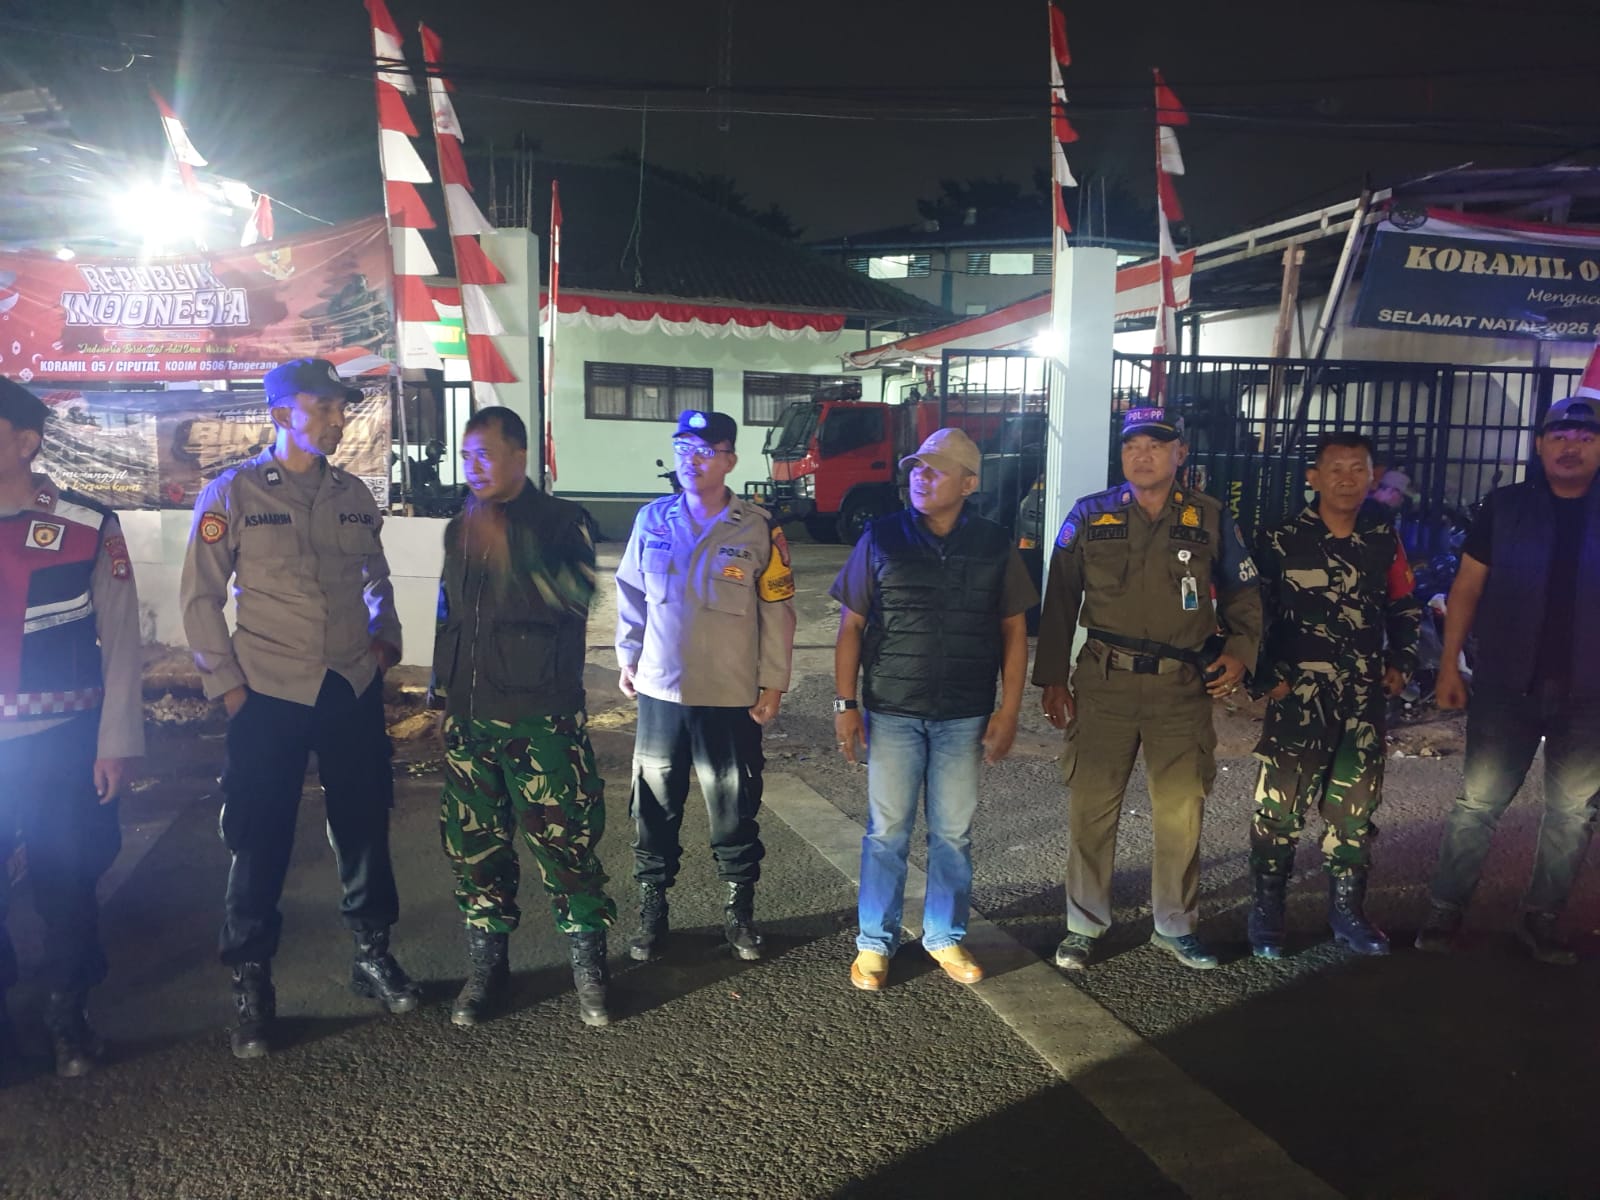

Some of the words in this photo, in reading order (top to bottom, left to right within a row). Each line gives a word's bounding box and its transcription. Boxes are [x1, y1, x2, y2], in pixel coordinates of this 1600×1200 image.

[1404, 246, 1573, 280] KORAMIL
[78, 264, 225, 291] REPUBLIK
[62, 289, 249, 327] INDONESIA
[1378, 309, 1476, 329] SELAMAT
[1479, 317, 1540, 333] NATAL
[1547, 322, 1589, 335] 2025
[40, 360, 87, 372] KORAMIL
[91, 361, 106, 372] 05
[165, 360, 197, 371] KODIM
